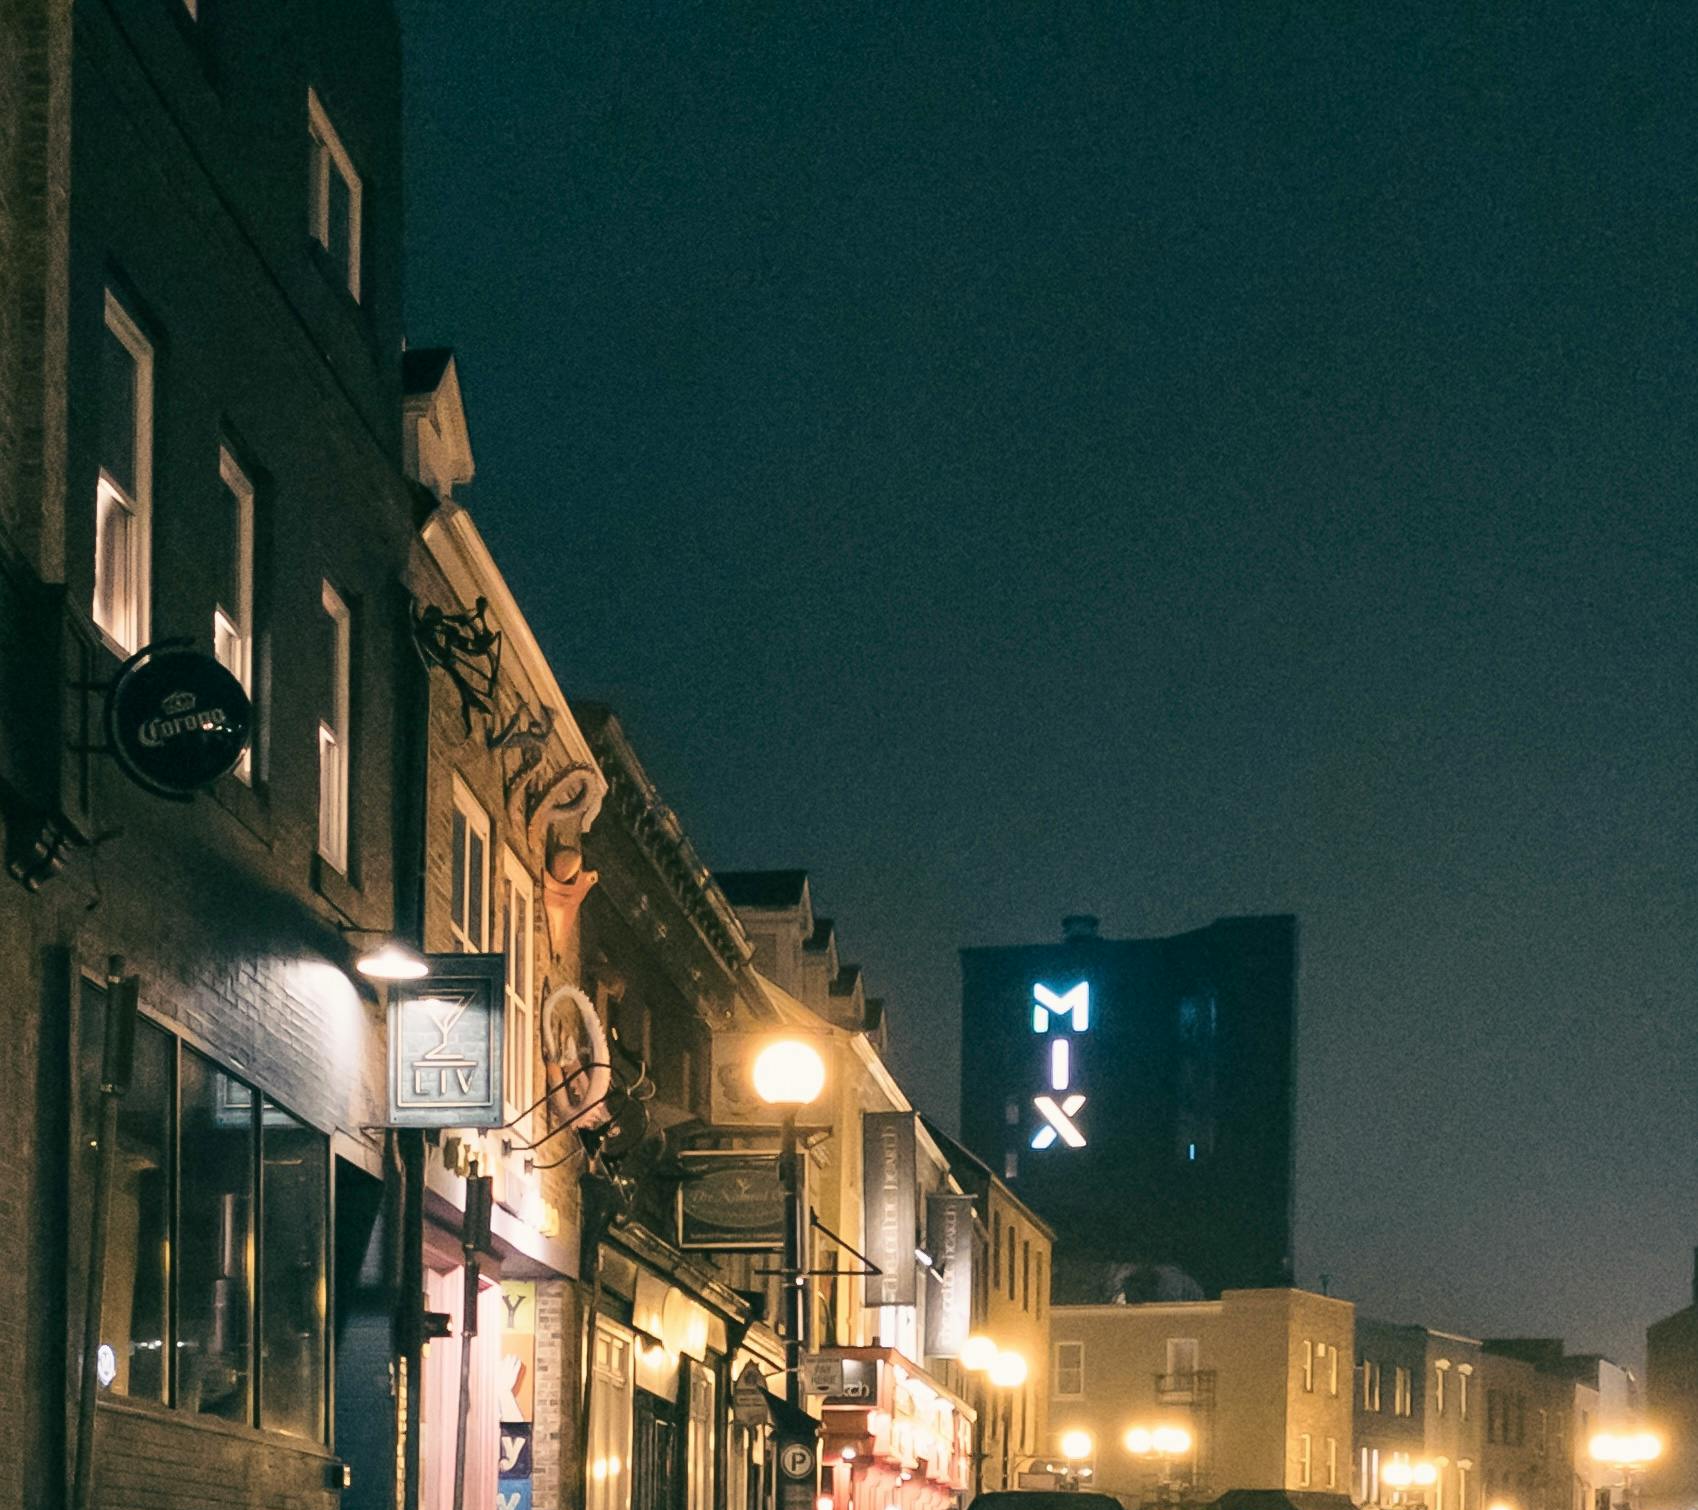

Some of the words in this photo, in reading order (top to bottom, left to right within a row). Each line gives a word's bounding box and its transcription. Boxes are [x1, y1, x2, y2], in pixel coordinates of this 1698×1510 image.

[137, 710, 226, 747] Corona
[414, 1068, 477, 1097] LIV
[1031, 982, 1089, 1149] MIX
